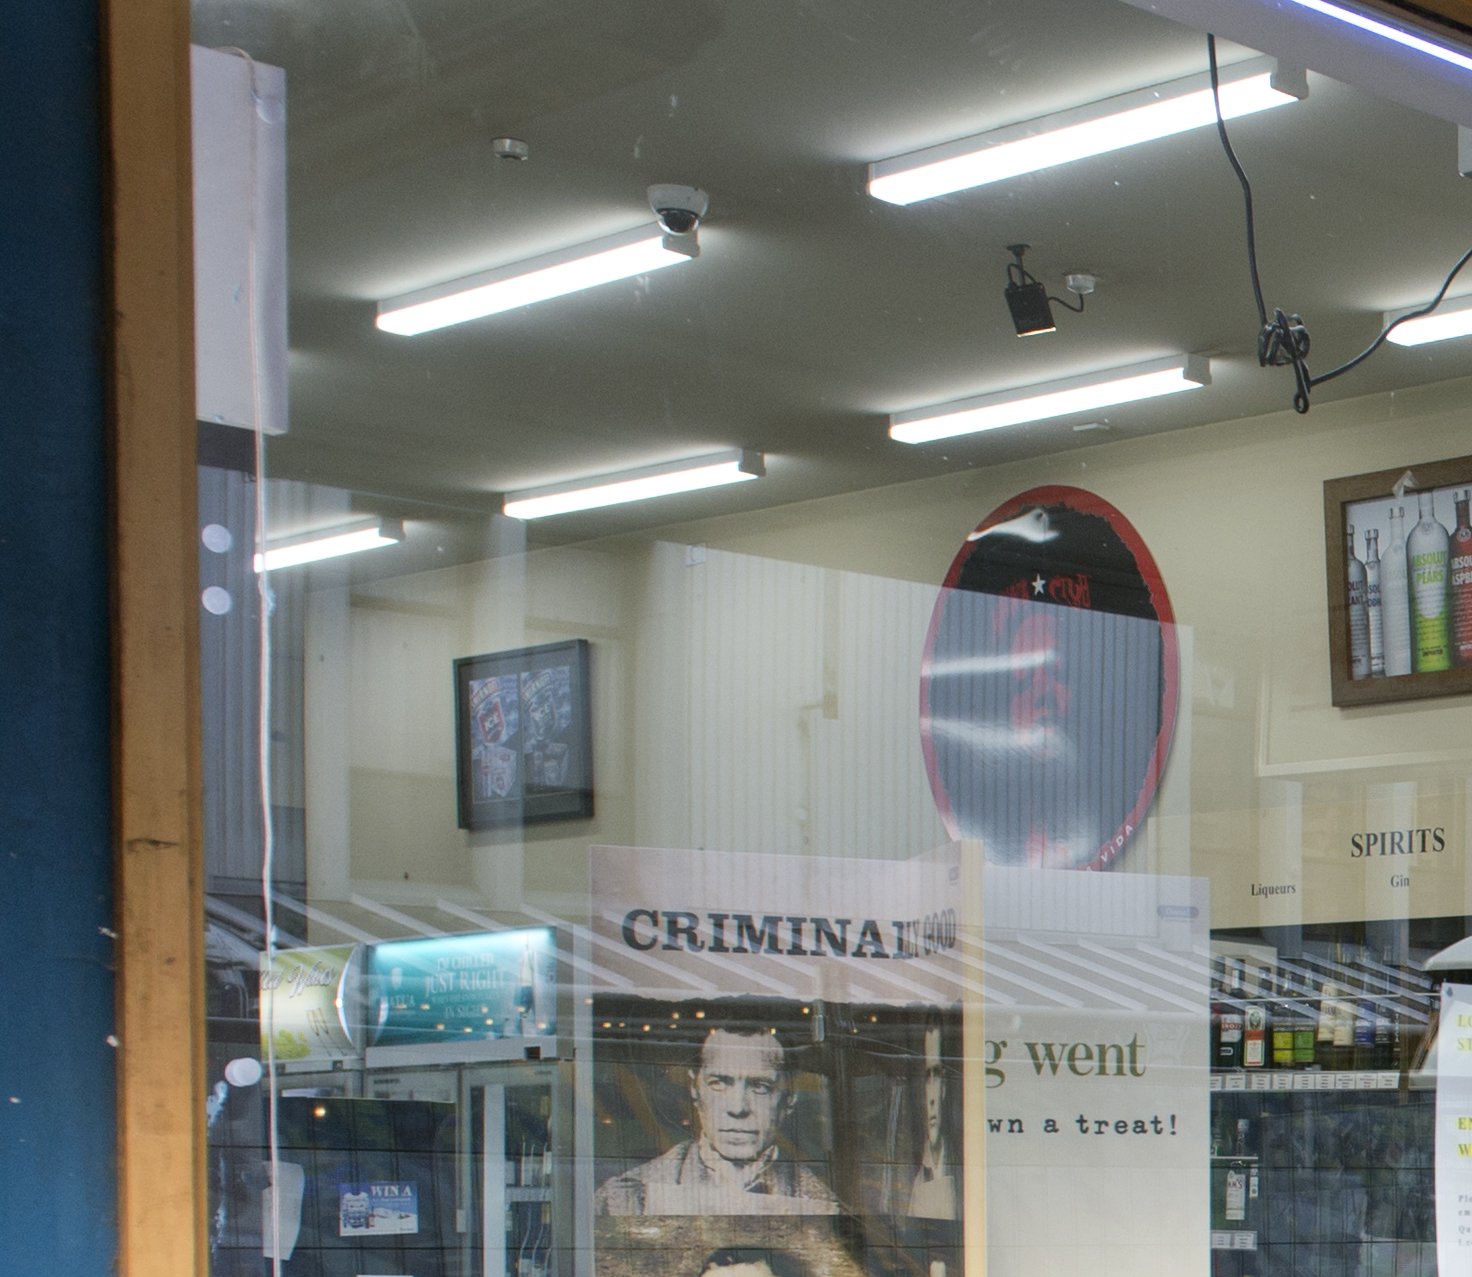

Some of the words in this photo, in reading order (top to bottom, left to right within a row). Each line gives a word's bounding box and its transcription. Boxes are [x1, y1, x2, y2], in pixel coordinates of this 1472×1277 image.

[1350, 827, 1445, 858] SPIRITS
[1251, 882, 1296, 899] Liqueurs
[1390, 875, 1410, 888] Gin
[1025, 1033, 1147, 1078] went
[1043, 1118, 1059, 1134] a
[1075, 1113, 1177, 1135] treat!
[370, 1185, 400, 1197] WIN
[402, 1184, 413, 1197] A
